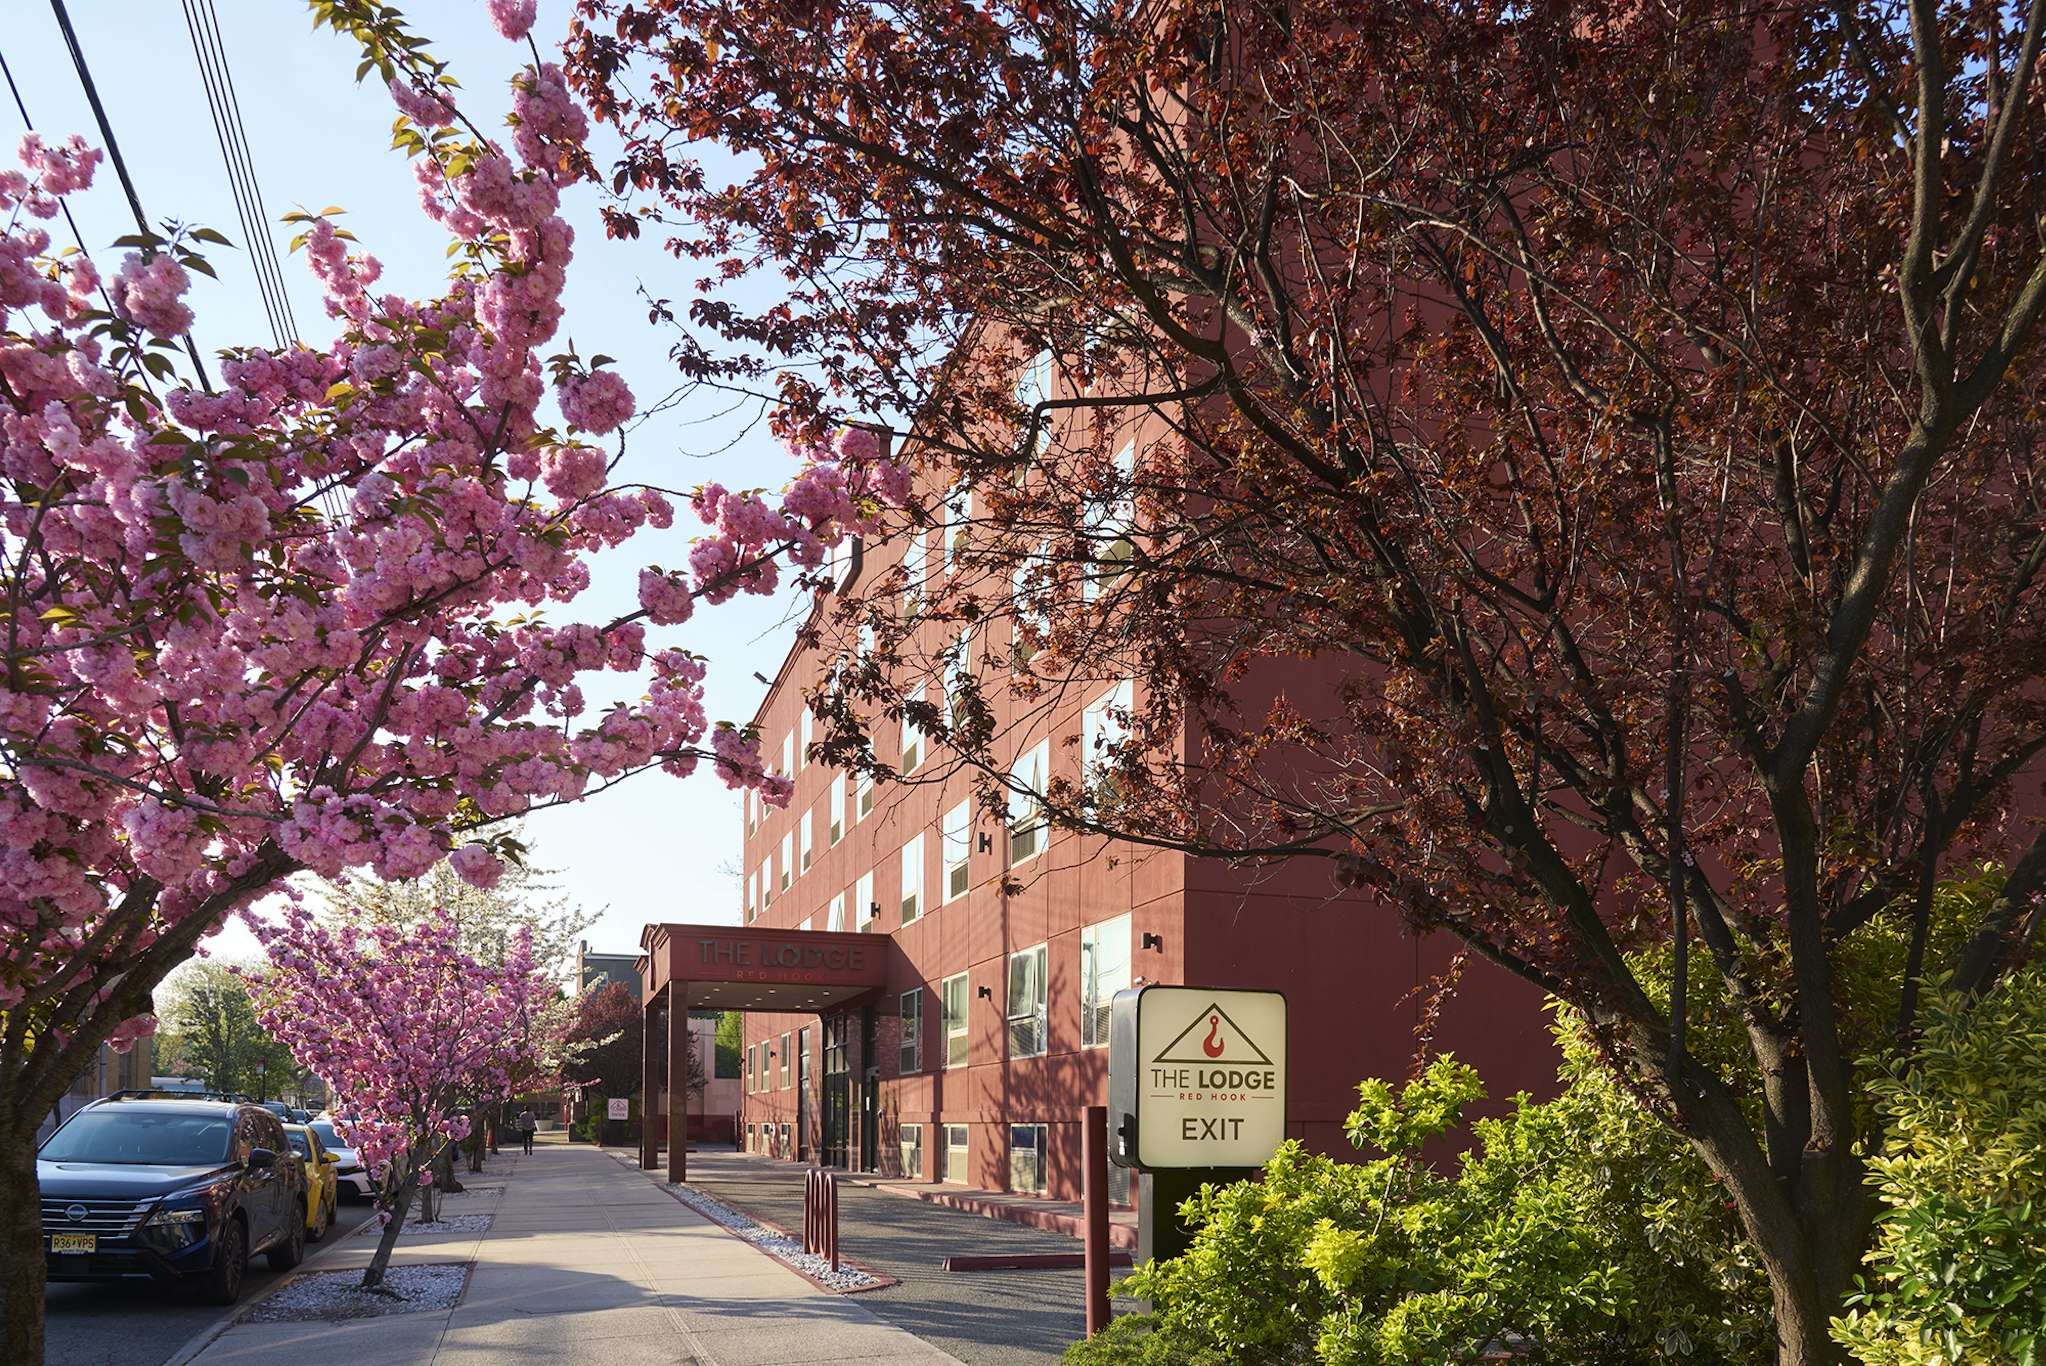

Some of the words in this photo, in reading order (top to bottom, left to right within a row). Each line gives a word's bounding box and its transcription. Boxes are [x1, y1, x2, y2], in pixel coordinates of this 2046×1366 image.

[697, 940, 751, 966] THE
[762, 943, 865, 970] LODGE
[736, 971, 767, 980] RED
[779, 972, 824, 982] HOOK
[1151, 1069, 1190, 1088] THE
[1198, 1070, 1275, 1090] LODGE
[1179, 1093, 1203, 1101] RED
[1211, 1093, 1246, 1101] HOOK
[1182, 1118, 1245, 1140] EXIT
